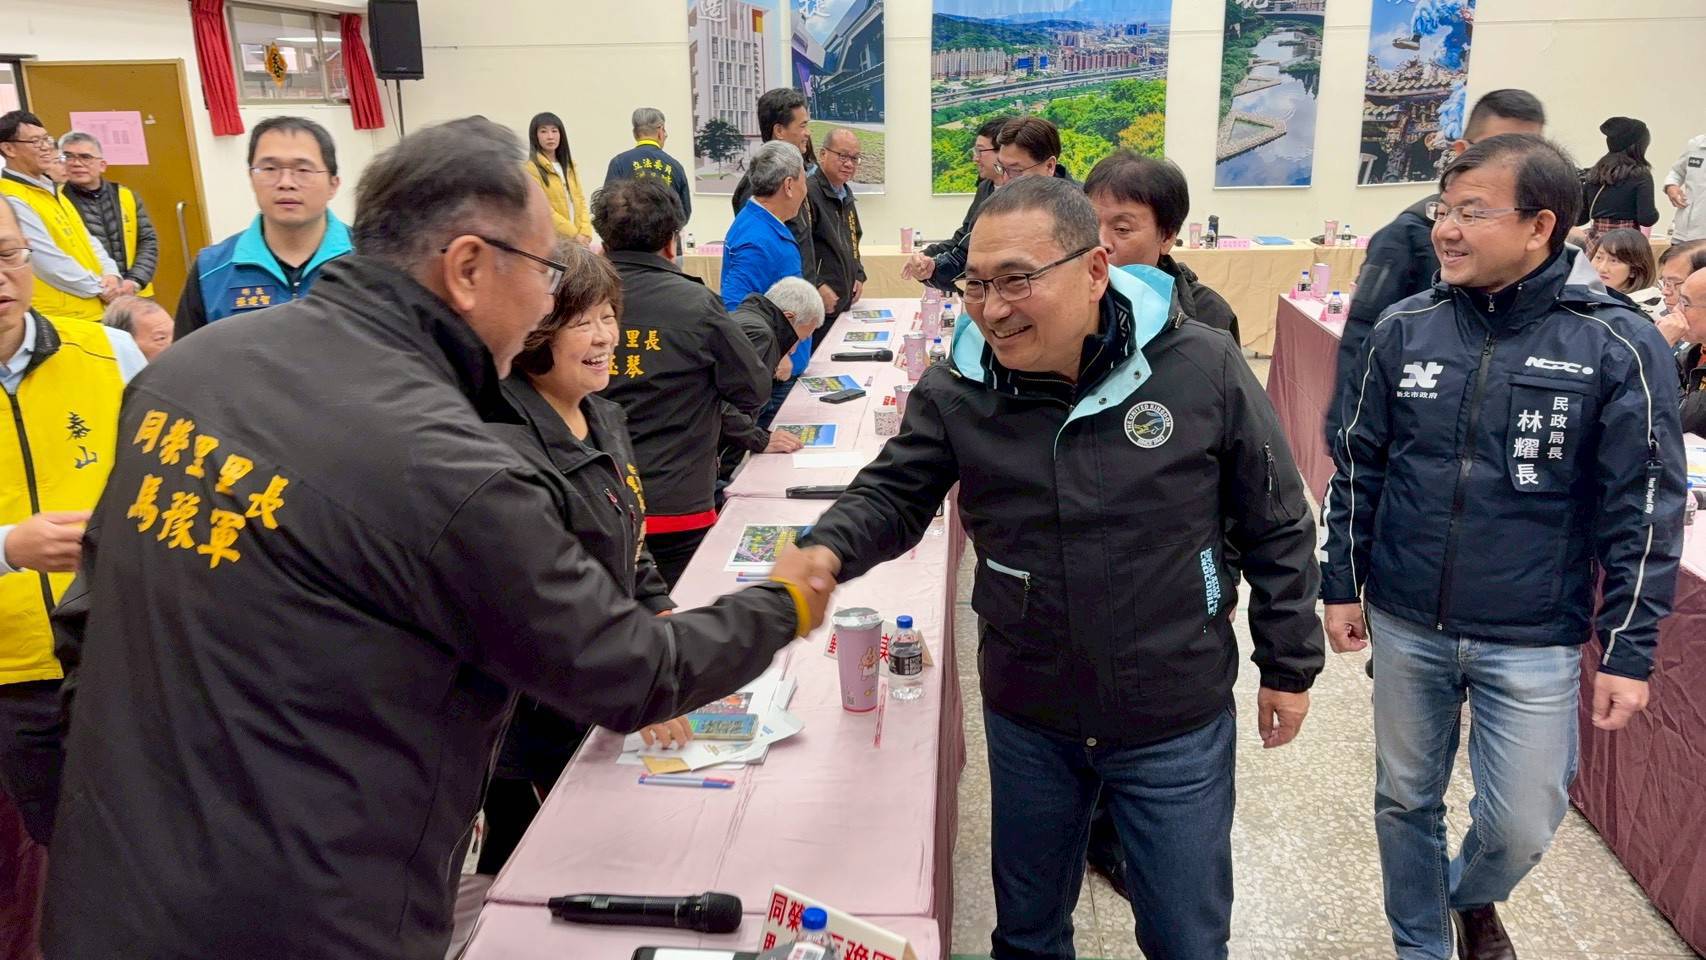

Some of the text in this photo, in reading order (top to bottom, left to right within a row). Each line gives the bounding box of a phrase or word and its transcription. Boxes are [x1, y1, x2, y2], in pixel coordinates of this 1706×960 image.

[632, 158, 672, 175] 立法委員
[625, 329, 662, 351] 里長
[65, 411, 98, 469] 泰山
[1128, 404, 1149, 420] UNITED
[1150, 404, 1171, 428] KINGDOM
[1547, 396, 1569, 460] 民政局長
[132, 409, 290, 530] 同榮里里長
[1513, 409, 1543, 485] 林耀長
[1200, 551, 1214, 615] CROCODILE
